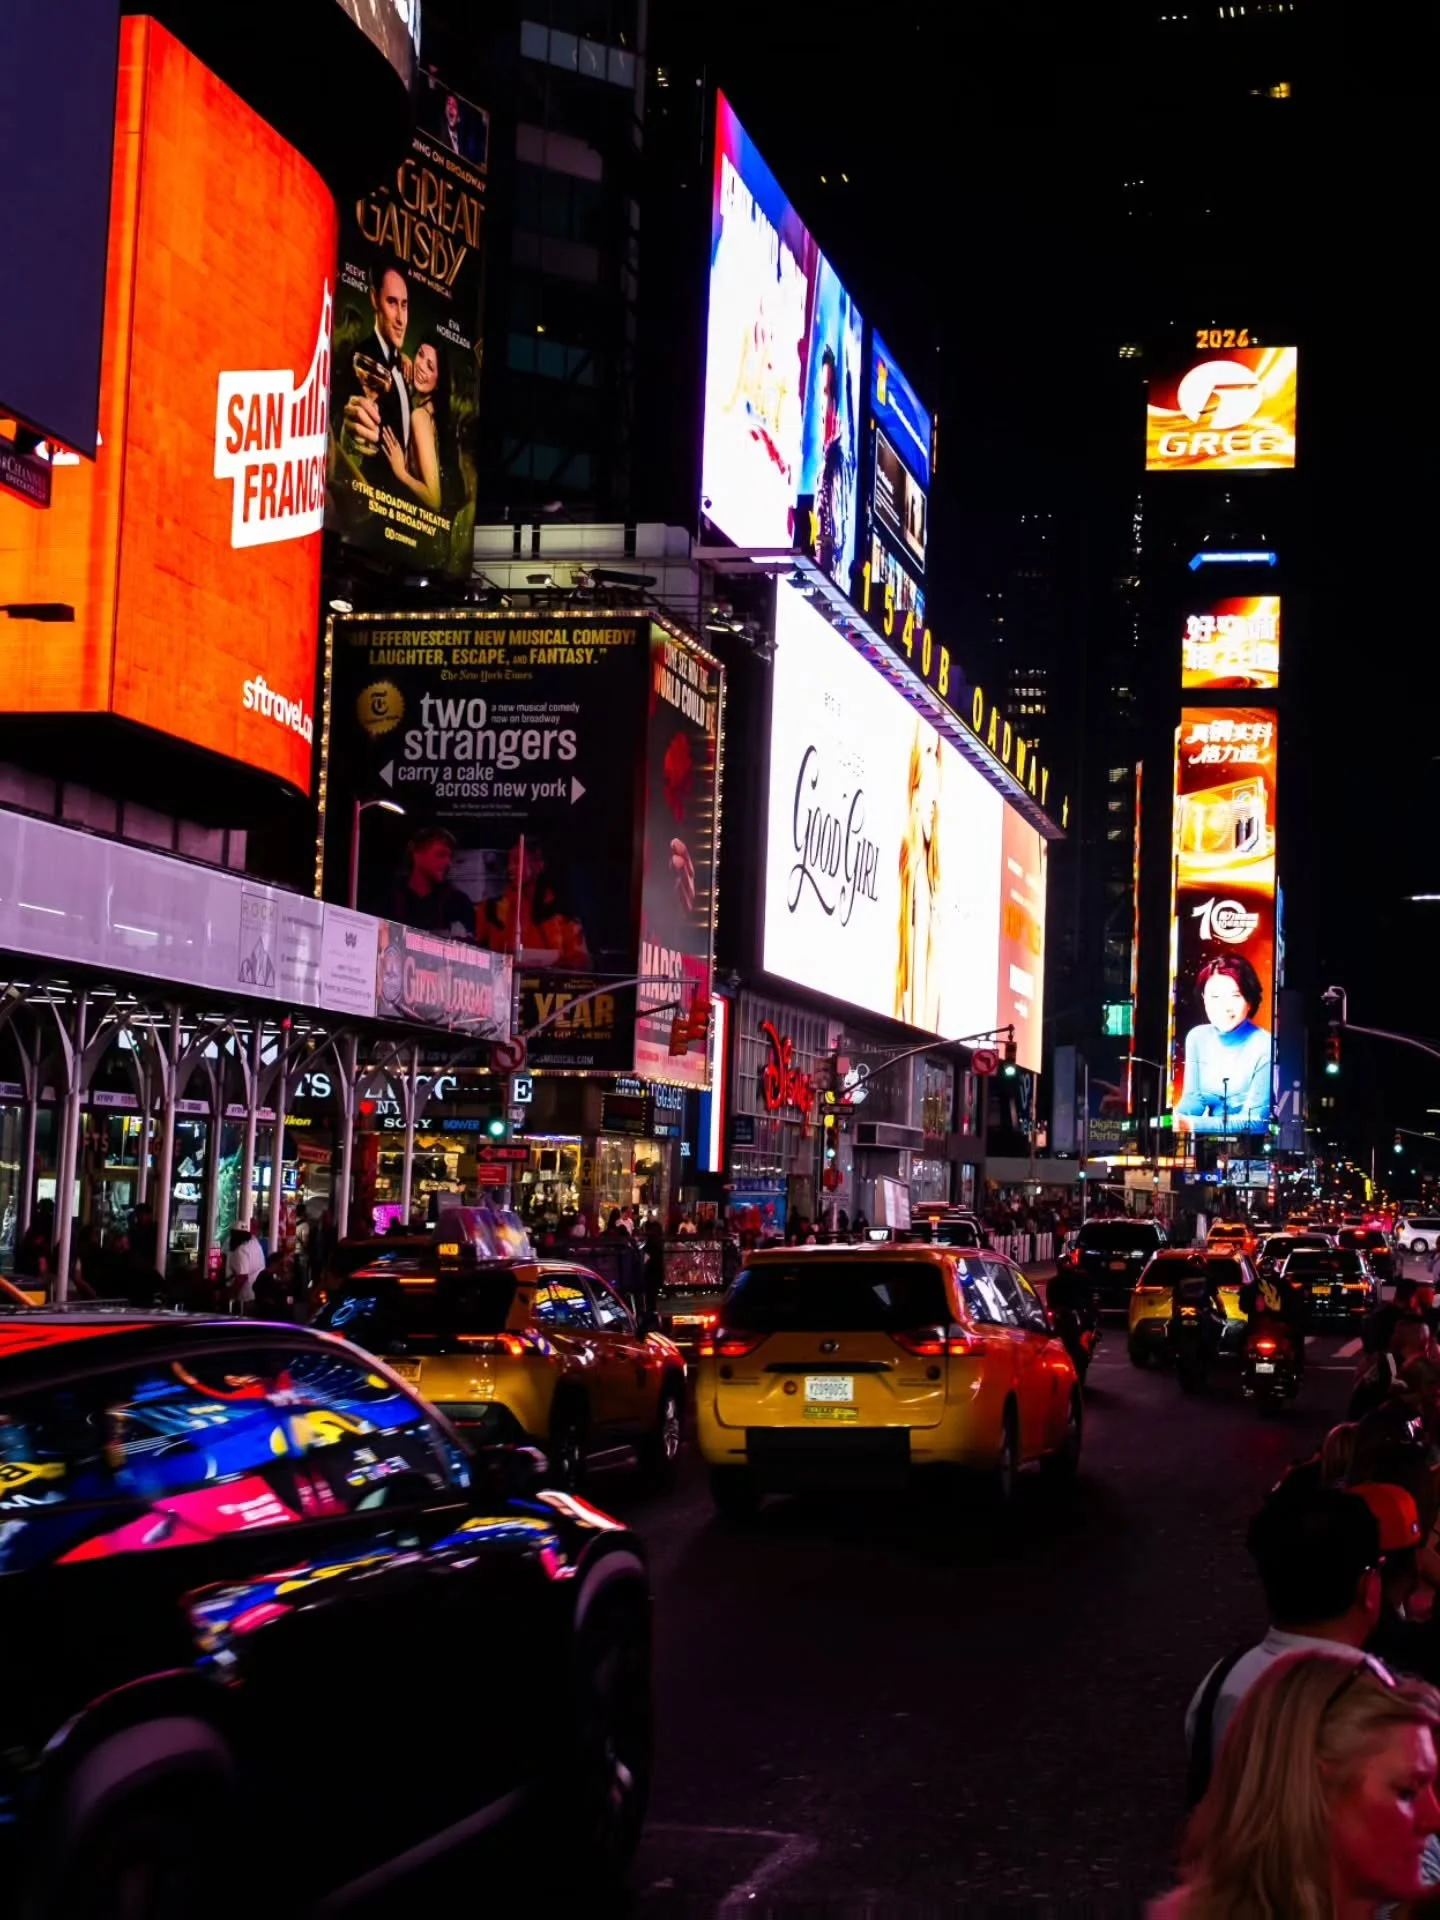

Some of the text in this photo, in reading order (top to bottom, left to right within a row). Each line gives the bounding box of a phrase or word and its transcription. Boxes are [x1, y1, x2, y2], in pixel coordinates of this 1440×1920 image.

[432, 151, 446, 167] ON
[446, 159, 487, 193] BROADWAY
[396, 157, 486, 249] GREAT
[355, 184, 468, 287] GATSBY
[448, 319, 461, 332] EVA
[1195, 329, 1250, 349] 2026
[225, 392, 285, 455] SAN
[375, 489, 418, 517] BROADWAY
[419, 508, 451, 531] THEATRE
[395, 511, 437, 537] BROADWAY
[371, 629, 473, 647] EFFERVESCENT
[474, 629, 507, 647] NEW
[508, 628, 570, 647] MUSICAL
[572, 627, 638, 646] COMEDY!
[369, 648, 448, 668] LAUGHTER,
[452, 647, 511, 666] ESCAPE,
[512, 655, 528, 665] AND
[440, 669, 534, 683] The New York Times
[420, 691, 487, 729] two
[491, 714, 561, 726] now on broadway
[498, 704, 515, 713] new
[516, 702, 548, 713] musical
[549, 702, 581, 715] comedy
[404, 727, 577, 770] strangers
[398, 761, 495, 785] carry a cake
[435, 777, 568, 803] across new york
[787, 744, 881, 928] GOOD GIRL
[532, 991, 616, 1029] YEAR
[284, 1114, 313, 1127] ikon
[383, 1117, 433, 1129] SOY
